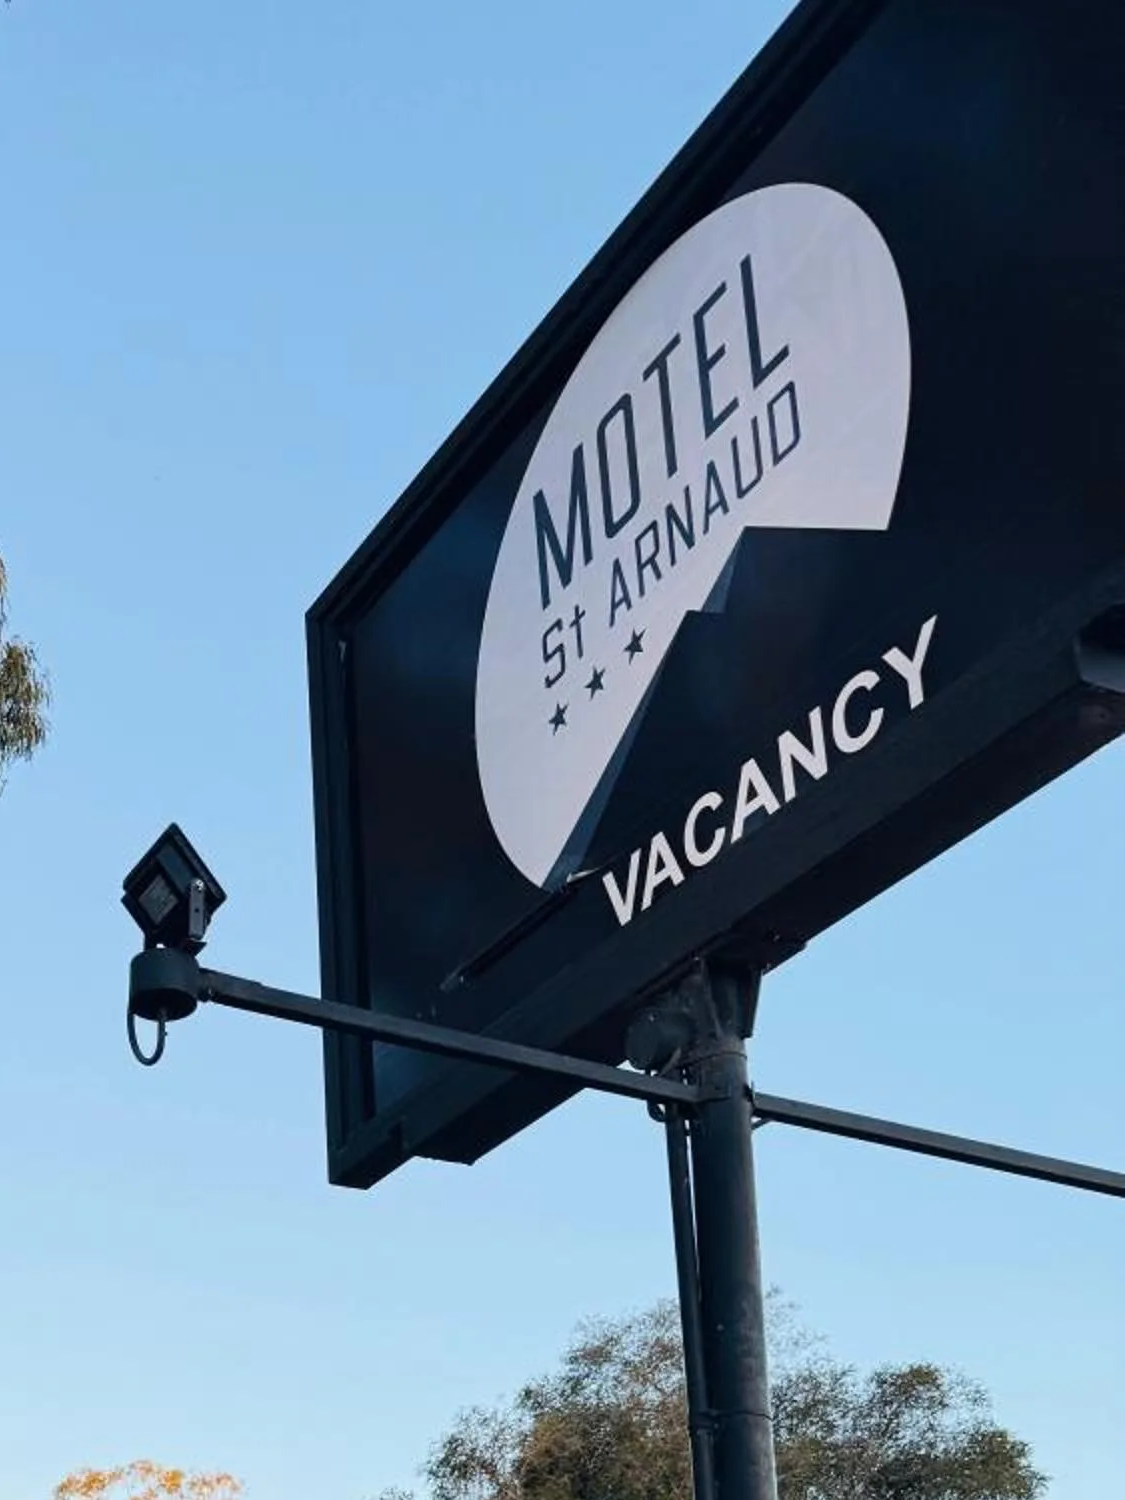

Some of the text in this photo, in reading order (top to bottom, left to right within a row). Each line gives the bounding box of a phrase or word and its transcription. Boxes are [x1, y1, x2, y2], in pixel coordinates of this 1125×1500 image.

[532, 255, 790, 609] MOTEL
[541, 380, 802, 689] St ARNAUD
[601, 614, 938, 927] VACANCY
